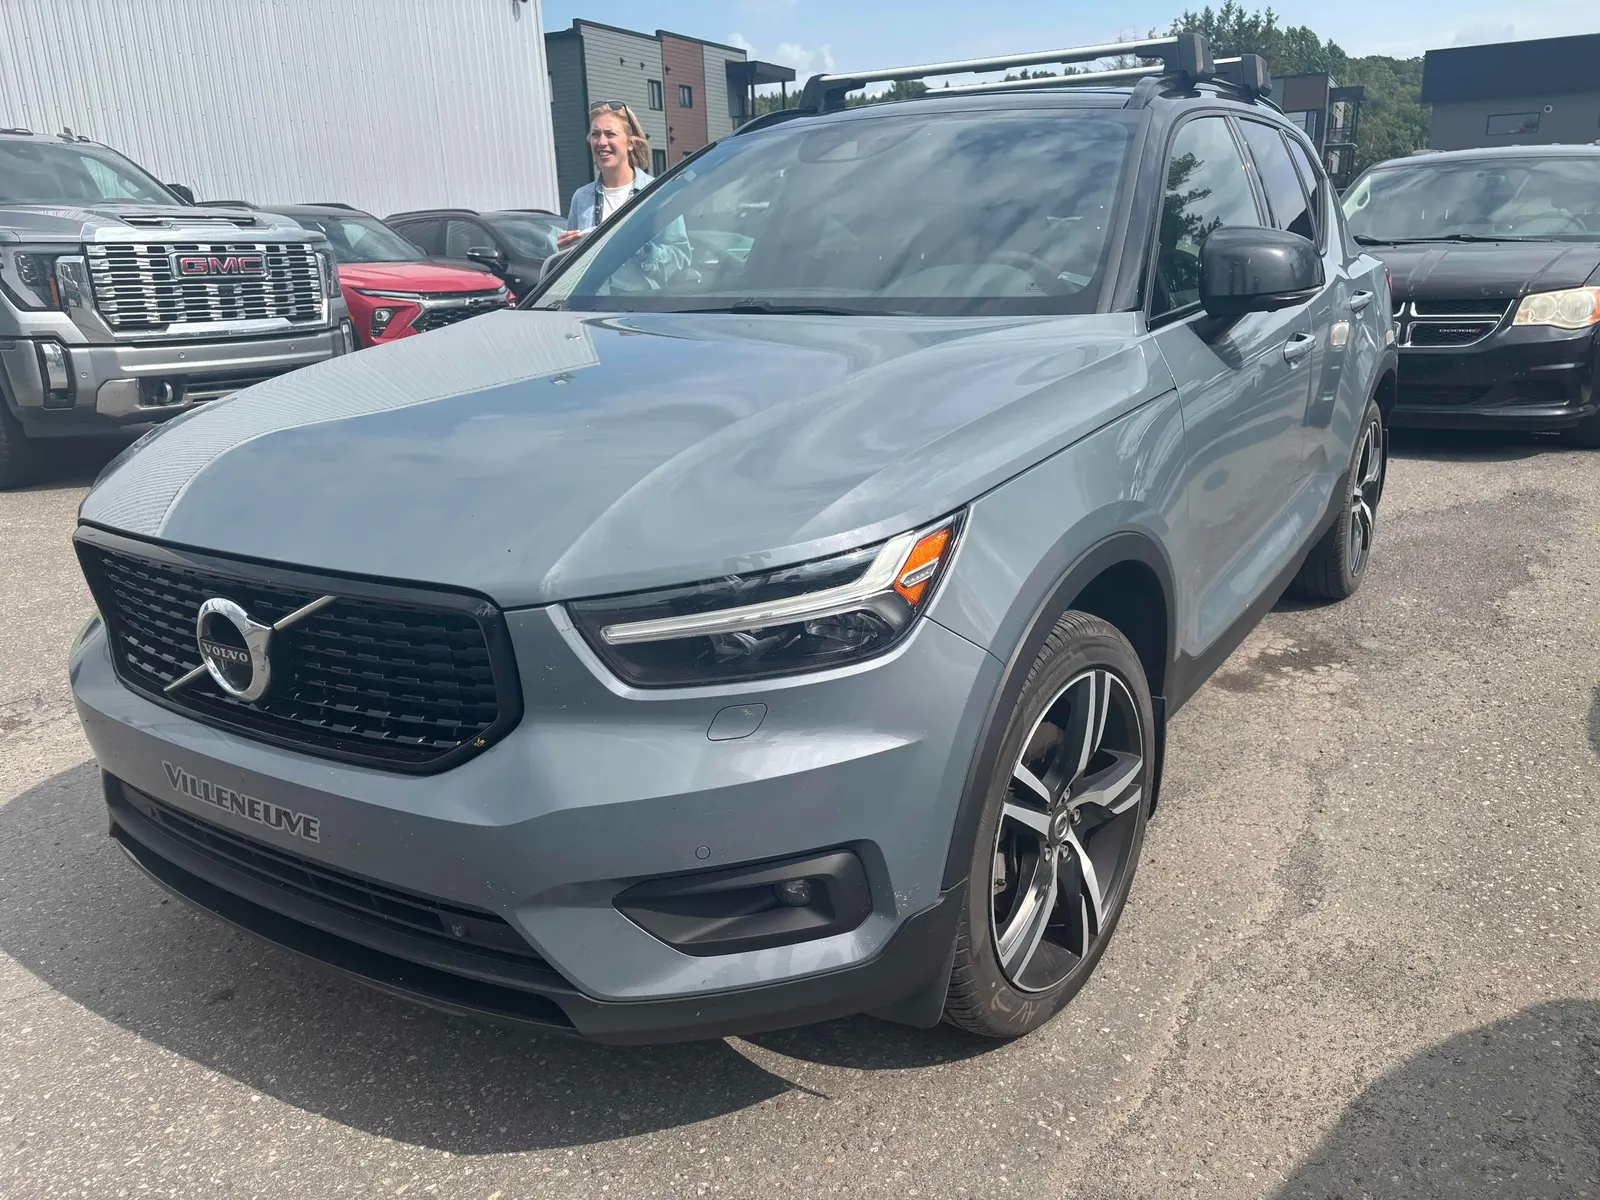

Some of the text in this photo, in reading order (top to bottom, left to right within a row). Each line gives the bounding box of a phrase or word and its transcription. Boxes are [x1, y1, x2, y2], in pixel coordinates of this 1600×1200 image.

[180, 257, 264, 275] GMC
[202, 642, 248, 662] VOLVO
[162, 760, 320, 844] VILLENEUVE
